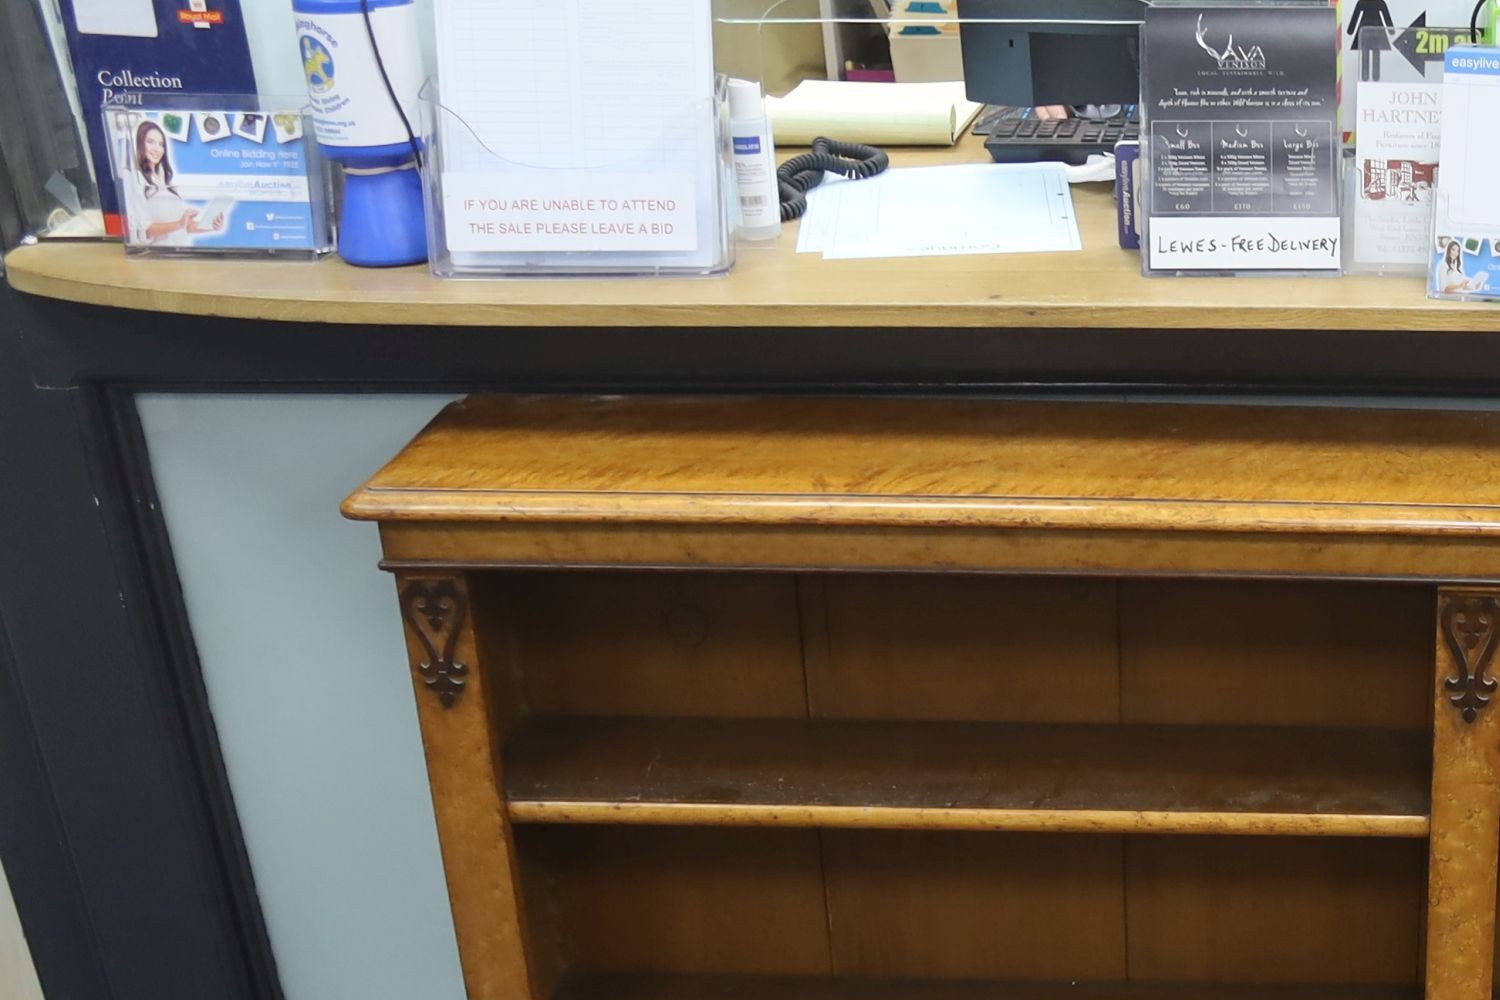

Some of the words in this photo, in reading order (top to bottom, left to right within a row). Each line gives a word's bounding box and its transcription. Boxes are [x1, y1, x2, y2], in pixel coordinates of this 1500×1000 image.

[1415, 31, 1448, 53] 2m
[1217, 60, 1266, 69] VENISON
[97, 69, 183, 89] Collection
[103, 88, 143, 105] Point
[1389, 91, 1438, 105] JOHN
[1362, 108, 1442, 124] HARTNE
[210, 148, 241, 158] Online
[241, 149, 276, 160] Bidding
[278, 150, 299, 159] Here
[464, 200, 475, 210] IF
[479, 200, 507, 211] YOU
[511, 200, 538, 210] ARE
[542, 200, 595, 211] UNABLE
[600, 200, 618, 210] TO
[622, 200, 676, 211] ATTEND
[470, 223, 494, 234] THE
[499, 223, 532, 234] SALE
[536, 223, 587, 234] PLEASE
[591, 224, 634, 234] LEAVE
[638, 224, 647, 234] A
[651, 224, 674, 234] BID
[1158, 235, 1218, 254] LEWES
[1231, 234, 1265, 253] FREE
[1267, 232, 1338, 257] DELIVERY
